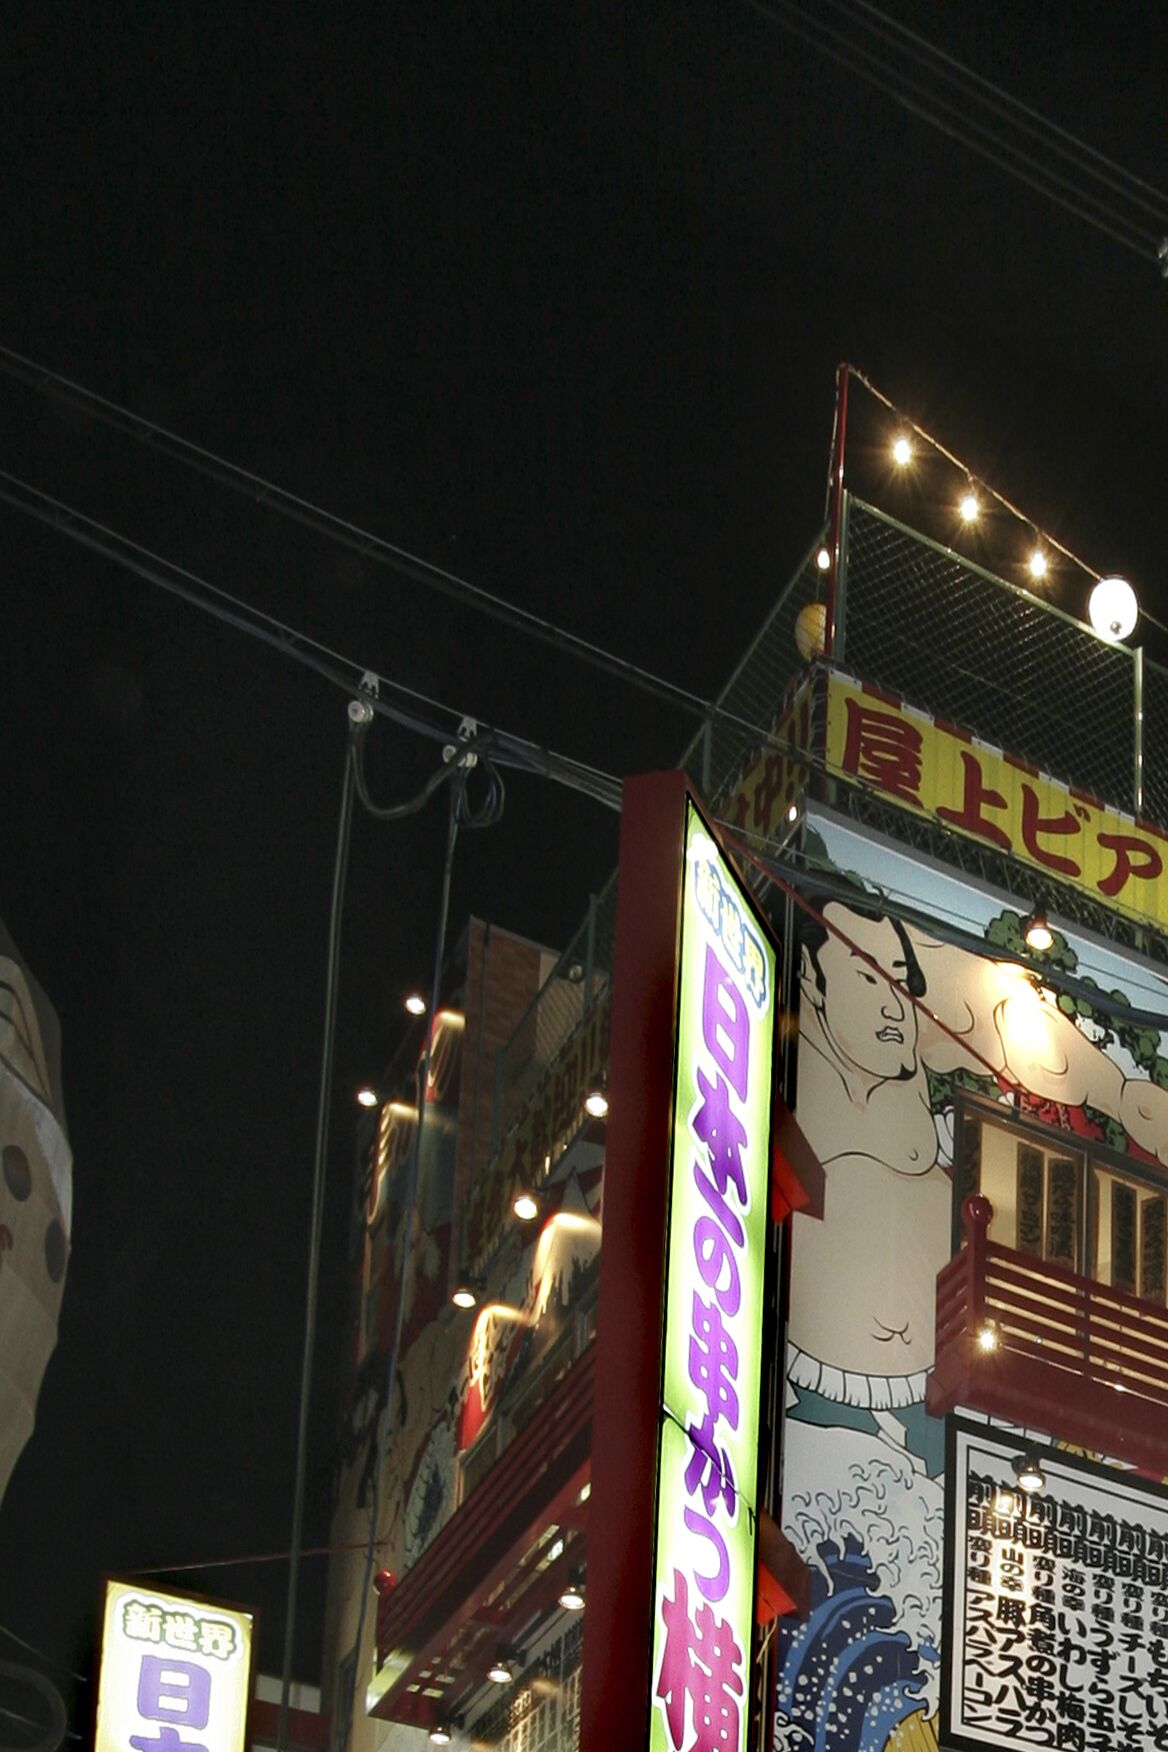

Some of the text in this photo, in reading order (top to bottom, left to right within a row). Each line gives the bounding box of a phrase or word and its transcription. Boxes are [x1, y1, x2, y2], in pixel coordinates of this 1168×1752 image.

[684, 944, 750, 1603] 日本一の串かつ
[123, 1601, 237, 1660] 新世界
[1025, 1600, 1058, 1747] 角煮の串かつ
